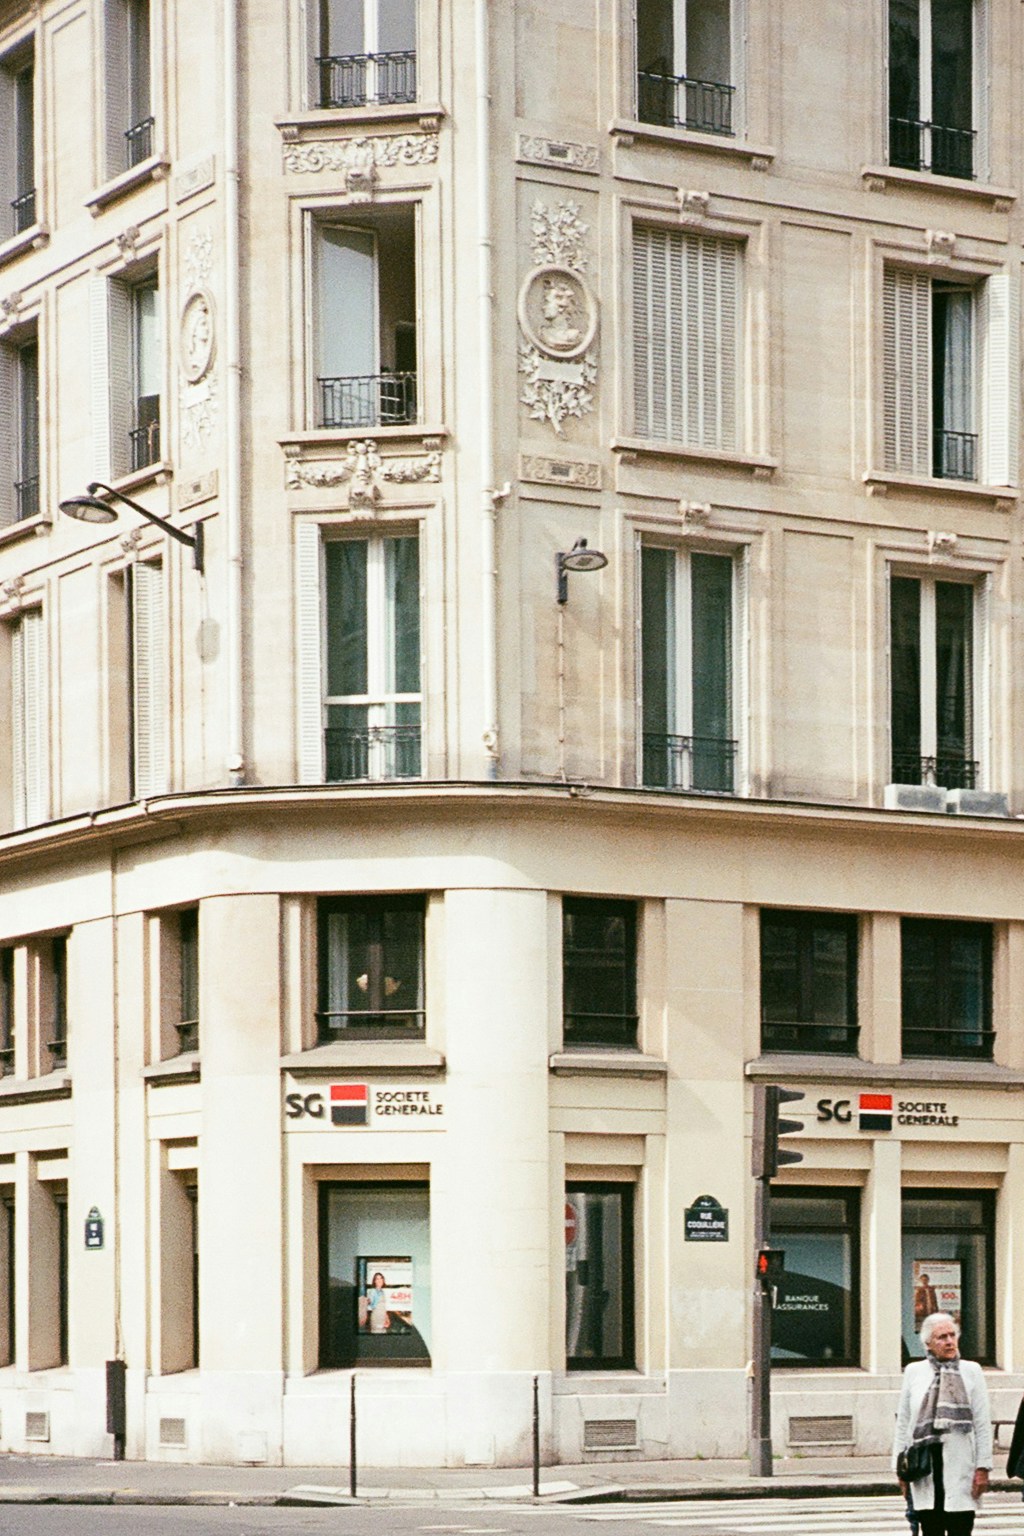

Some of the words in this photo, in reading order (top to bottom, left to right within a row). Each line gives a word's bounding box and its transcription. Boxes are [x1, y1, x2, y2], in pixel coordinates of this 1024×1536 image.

[376, 1091, 429, 1103] SOCIETE
[286, 1093, 324, 1118] SG
[375, 1104, 443, 1116] GENERALE
[817, 1099, 852, 1123] SG
[898, 1102, 947, 1114] SOCIETE
[897, 1114, 959, 1127] GENERALE
[776, 1303, 829, 1311] ASSURANCES
